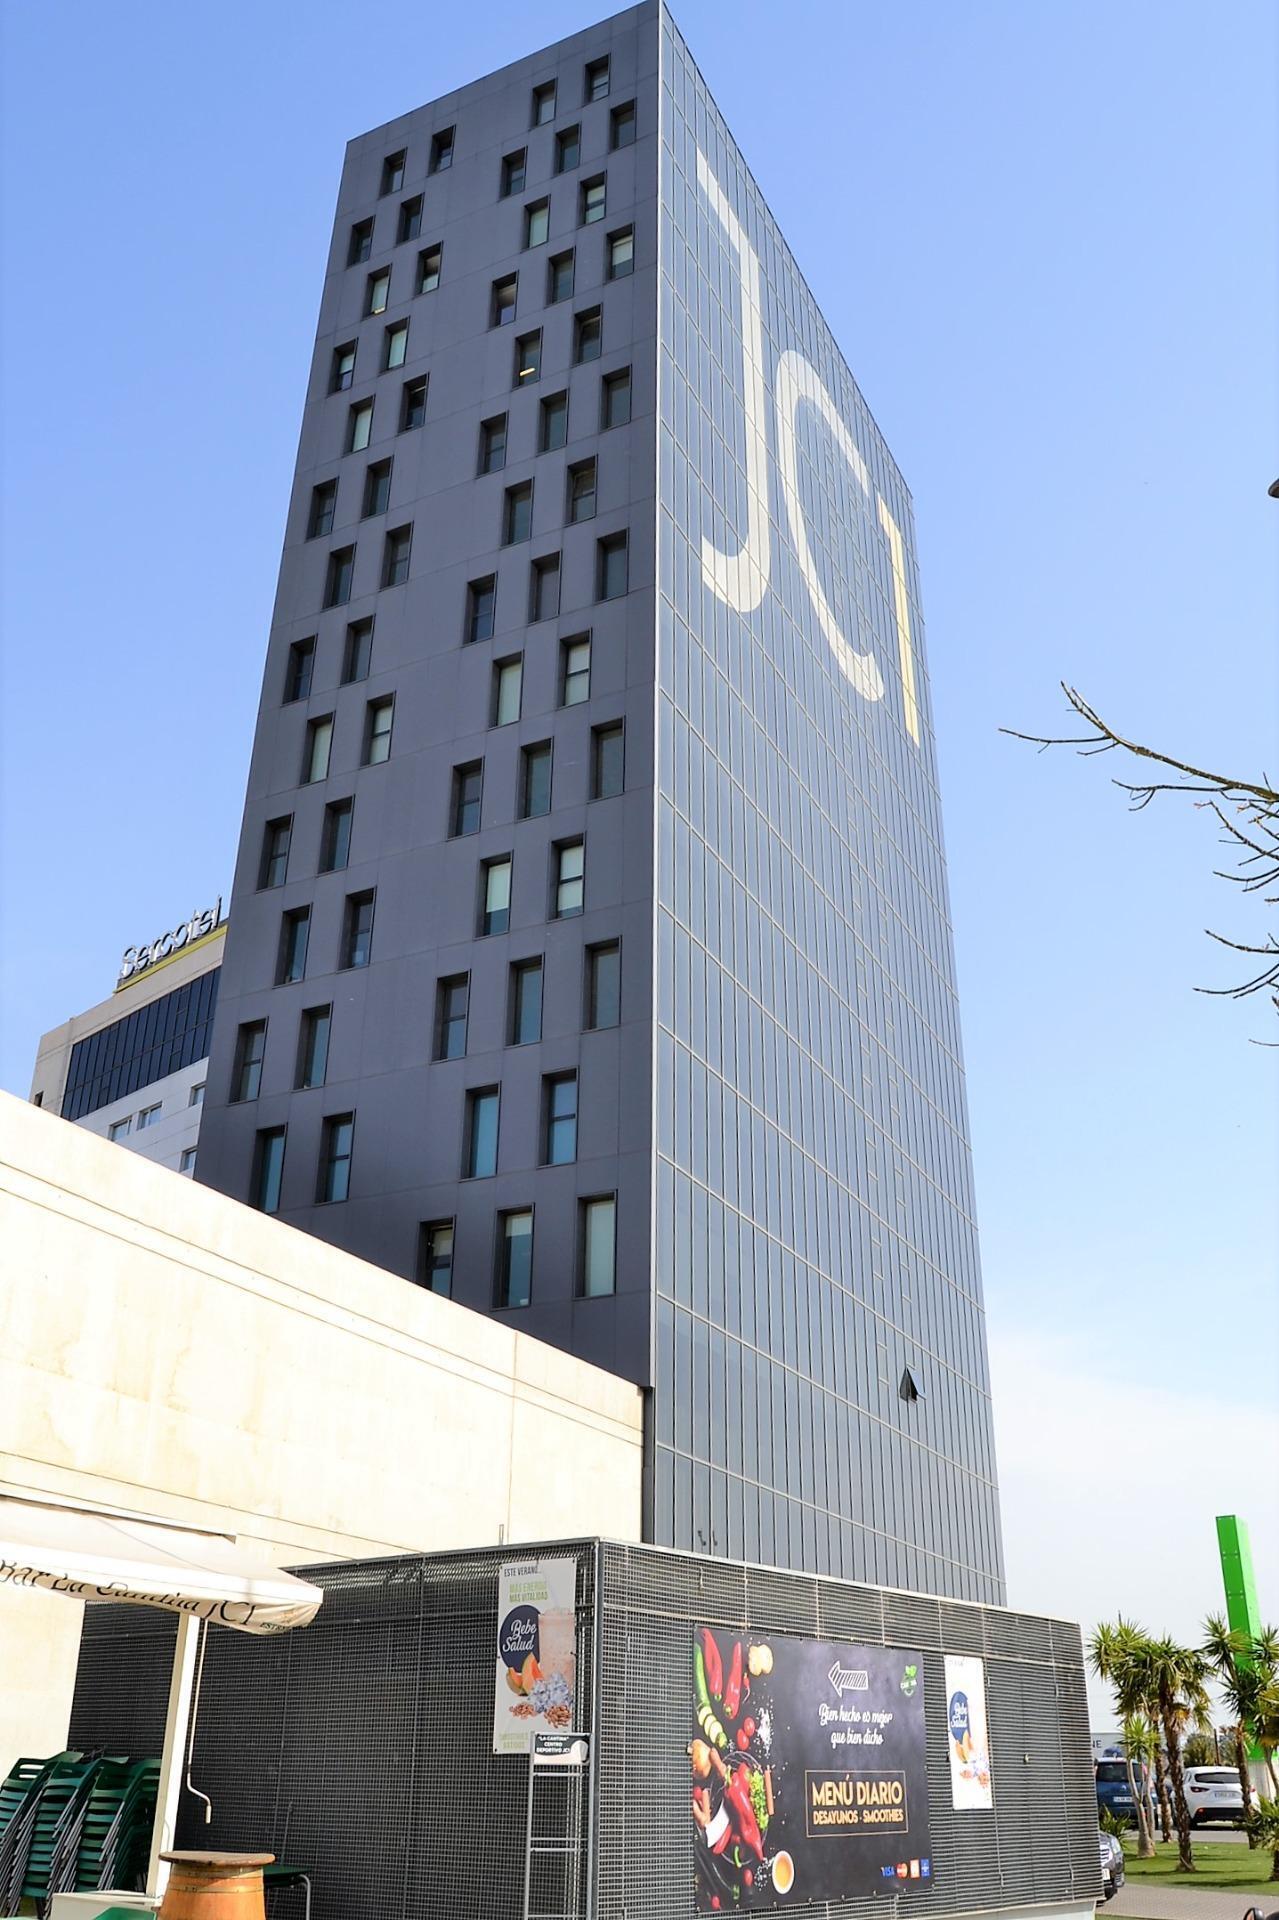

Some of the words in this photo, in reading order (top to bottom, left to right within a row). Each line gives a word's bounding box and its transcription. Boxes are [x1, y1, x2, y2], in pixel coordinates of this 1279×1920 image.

[120, 894, 222, 979] Sercotel
[504, 1568, 517, 1577] ESTE
[511, 1619, 537, 1640] Bebe
[502, 1635, 535, 1652] Salud
[819, 1703, 839, 1726] Bien
[839, 1705, 861, 1722] hecho
[862, 1711, 871, 1723] es
[871, 1709, 893, 1728] mejor
[830, 1732, 846, 1749] que
[846, 1727, 862, 1744] bien
[863, 1728, 884, 1745] dicho
[812, 1774, 854, 1806] MENÚ
[856, 1781, 903, 1805] DIARIO
[813, 1809, 858, 1825] DESAYUNOS
[863, 1808, 904, 1823] SMOOTHIES
